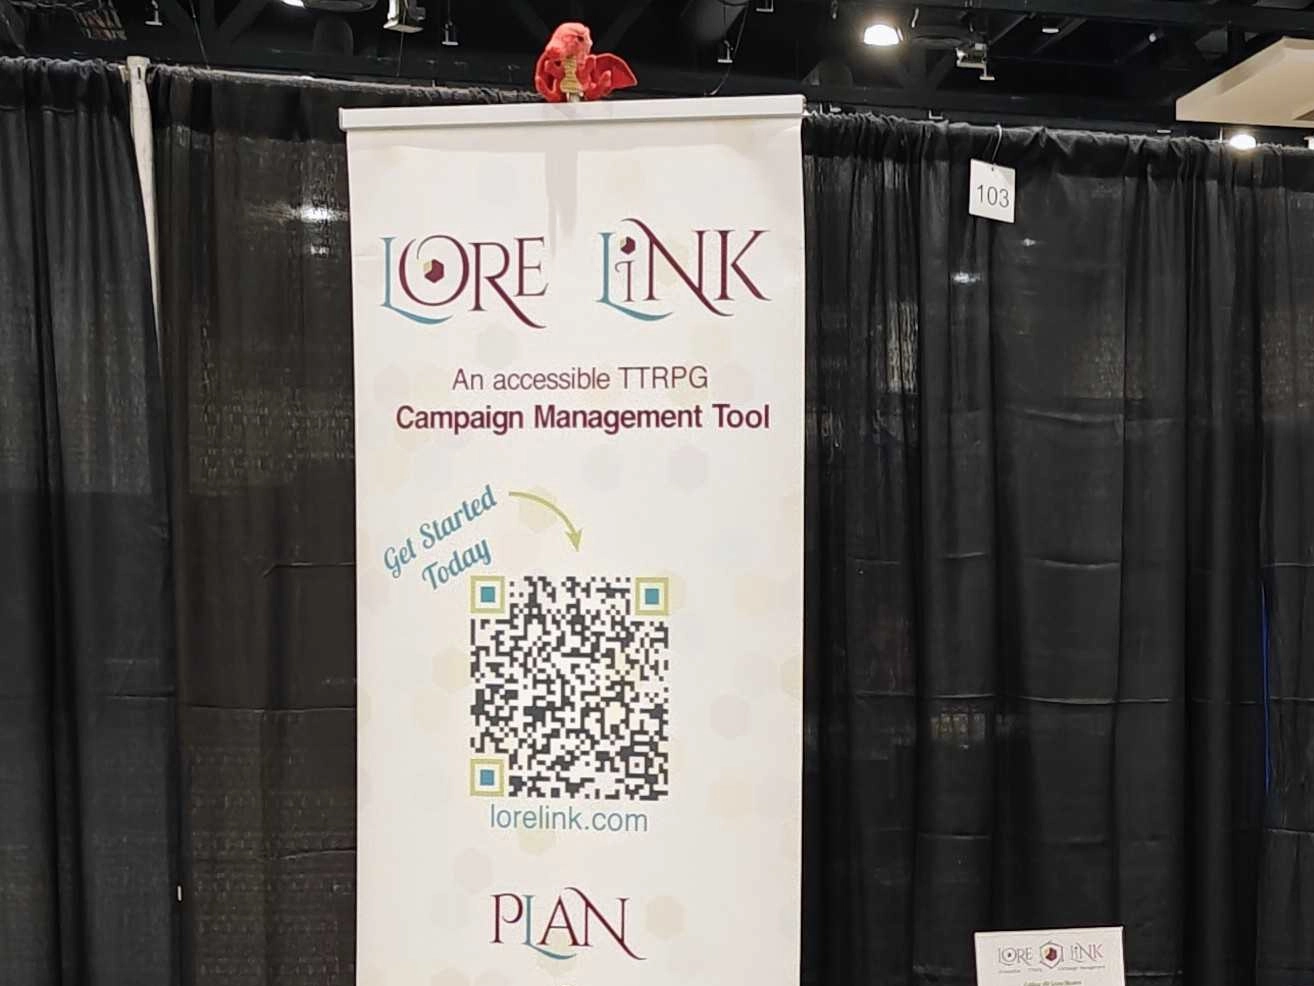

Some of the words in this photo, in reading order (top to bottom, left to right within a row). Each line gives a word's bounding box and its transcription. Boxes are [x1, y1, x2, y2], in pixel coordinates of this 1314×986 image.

[976, 184, 1010, 208] 103
[380, 234, 549, 329] LORE
[452, 368, 484, 390] An
[493, 366, 611, 391] accessible
[618, 366, 709, 390] TTRPG
[396, 404, 524, 435] Campaign
[534, 404, 703, 435] Management
[712, 403, 770, 429] Tool
[383, 537, 417, 579] Get
[421, 484, 497, 549] Started
[421, 537, 493, 591] Today
[490, 803, 648, 832] lorelink.com
[489, 887, 648, 960] PLAN
